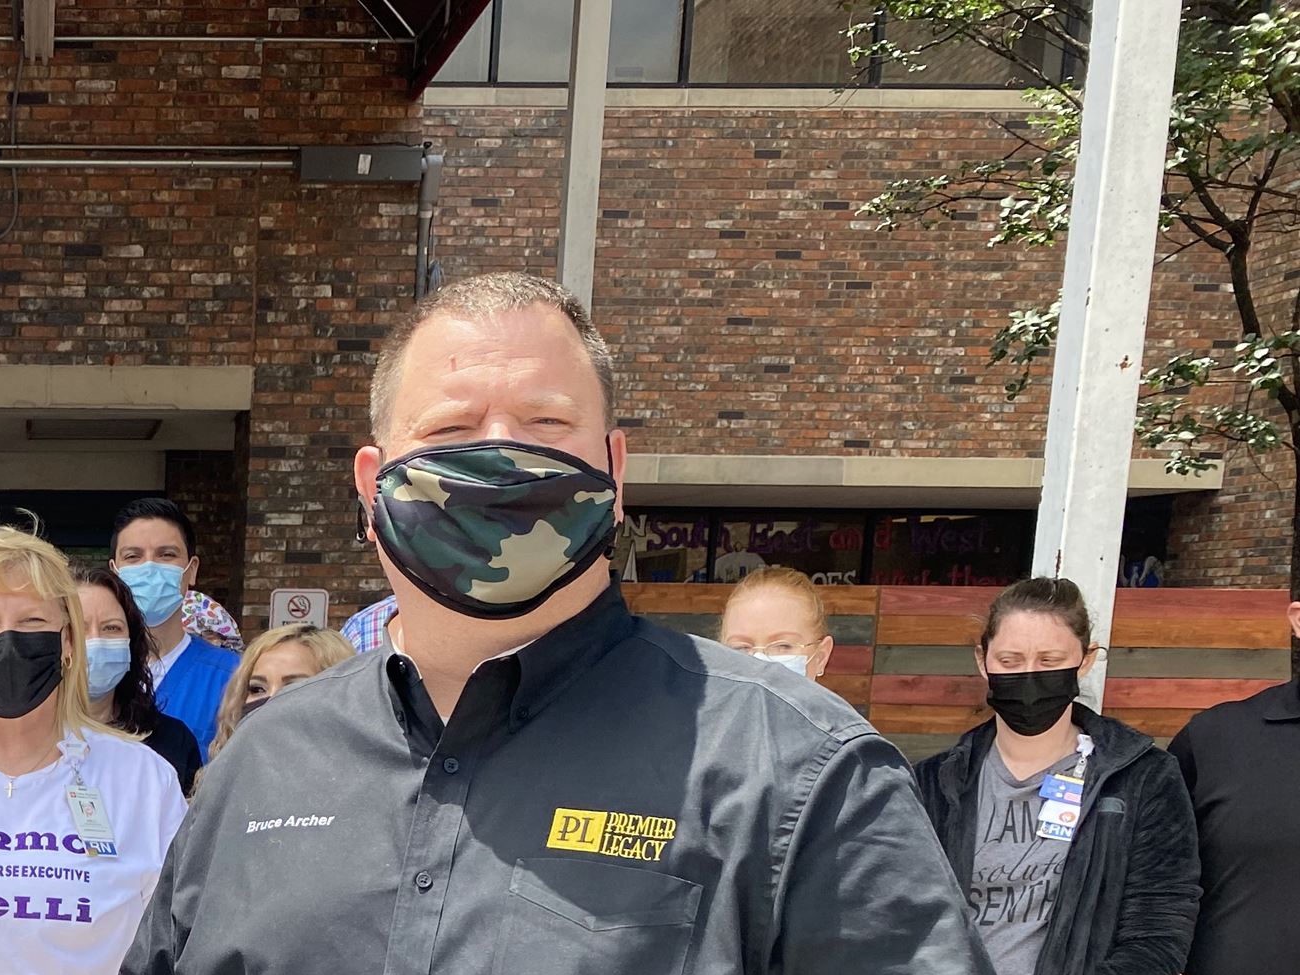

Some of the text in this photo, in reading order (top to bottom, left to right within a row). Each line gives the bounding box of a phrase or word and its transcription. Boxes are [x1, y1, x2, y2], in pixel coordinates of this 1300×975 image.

[245, 814, 335, 833] Bruce Archer
[556, 815, 596, 844] PL
[605, 812, 676, 839] PREMIER
[88, 840, 113, 855] RN
[600, 833, 667, 861] LEGACY
[21, 866, 90, 883] EXECUTIVE
